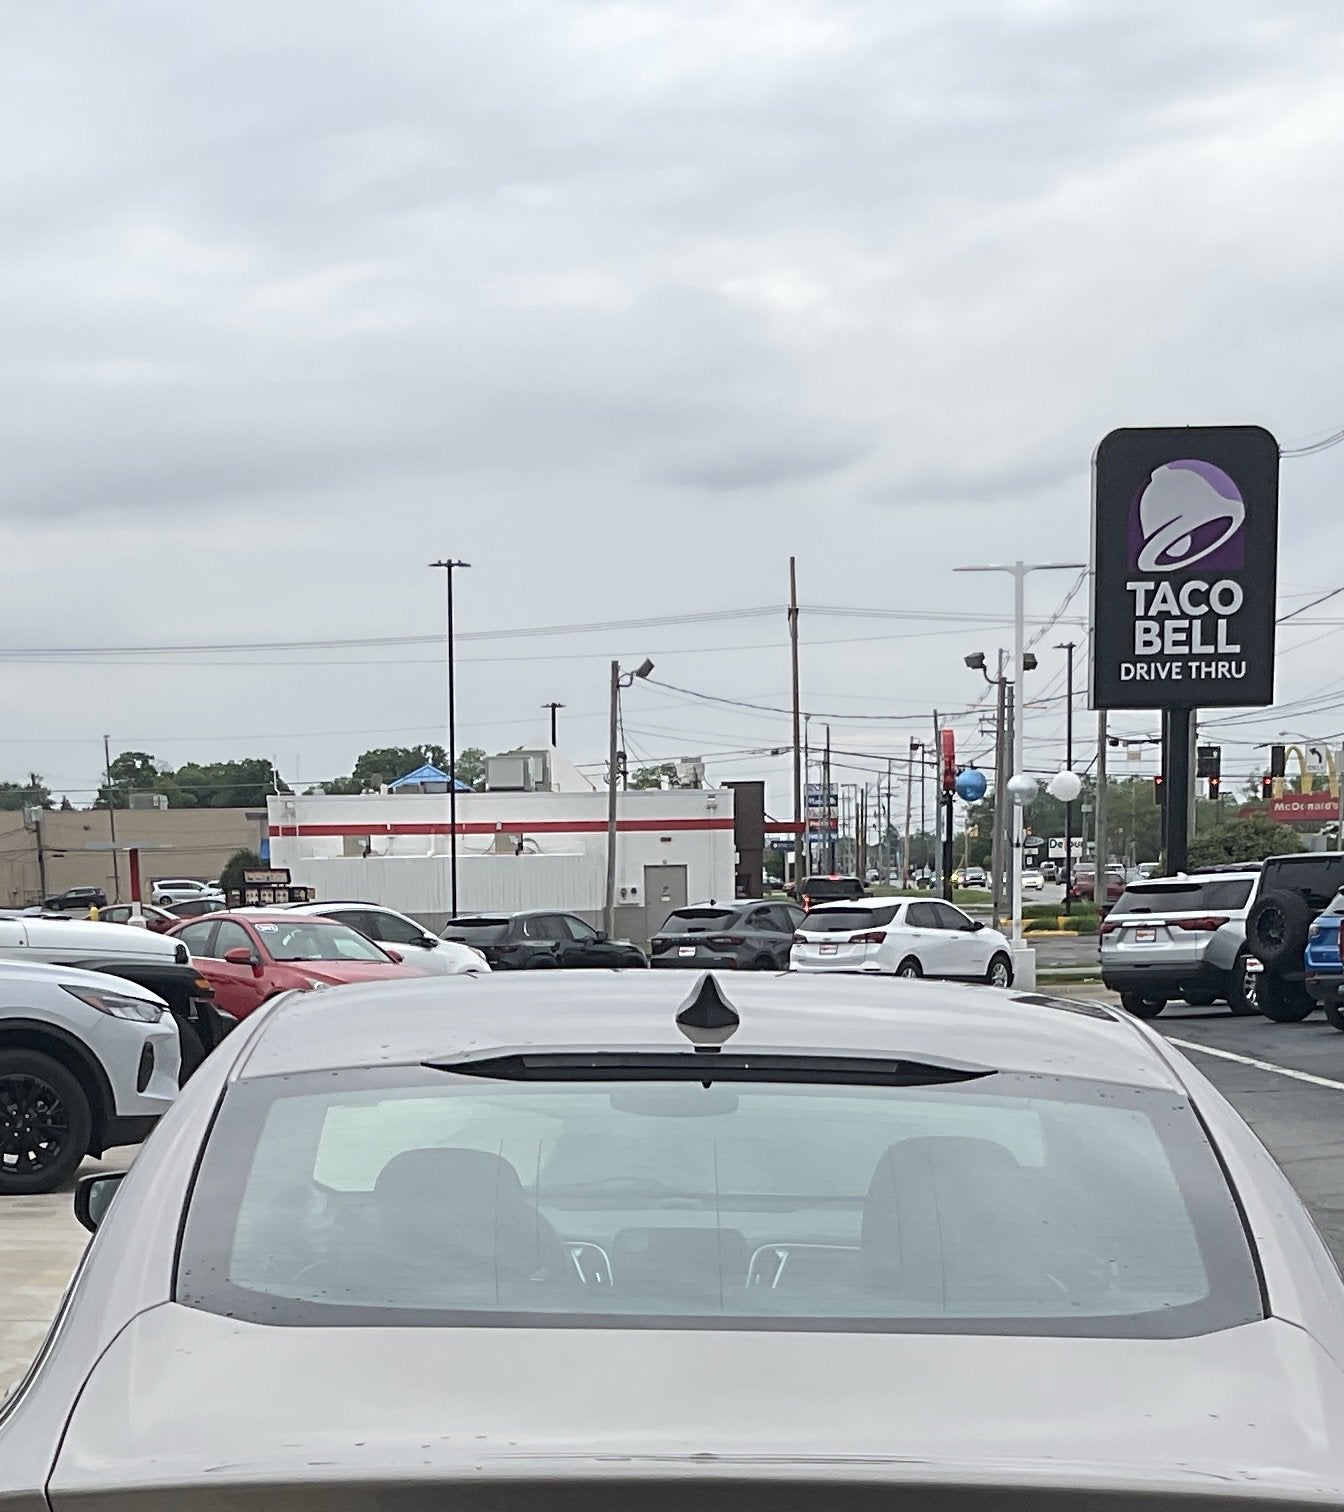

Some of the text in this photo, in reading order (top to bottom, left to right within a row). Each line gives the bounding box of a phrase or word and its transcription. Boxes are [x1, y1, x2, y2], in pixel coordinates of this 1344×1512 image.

[1126, 579, 1244, 616] TACO
[1134, 618, 1241, 655] BELL
[1120, 661, 1246, 681] DRIVE THRU
